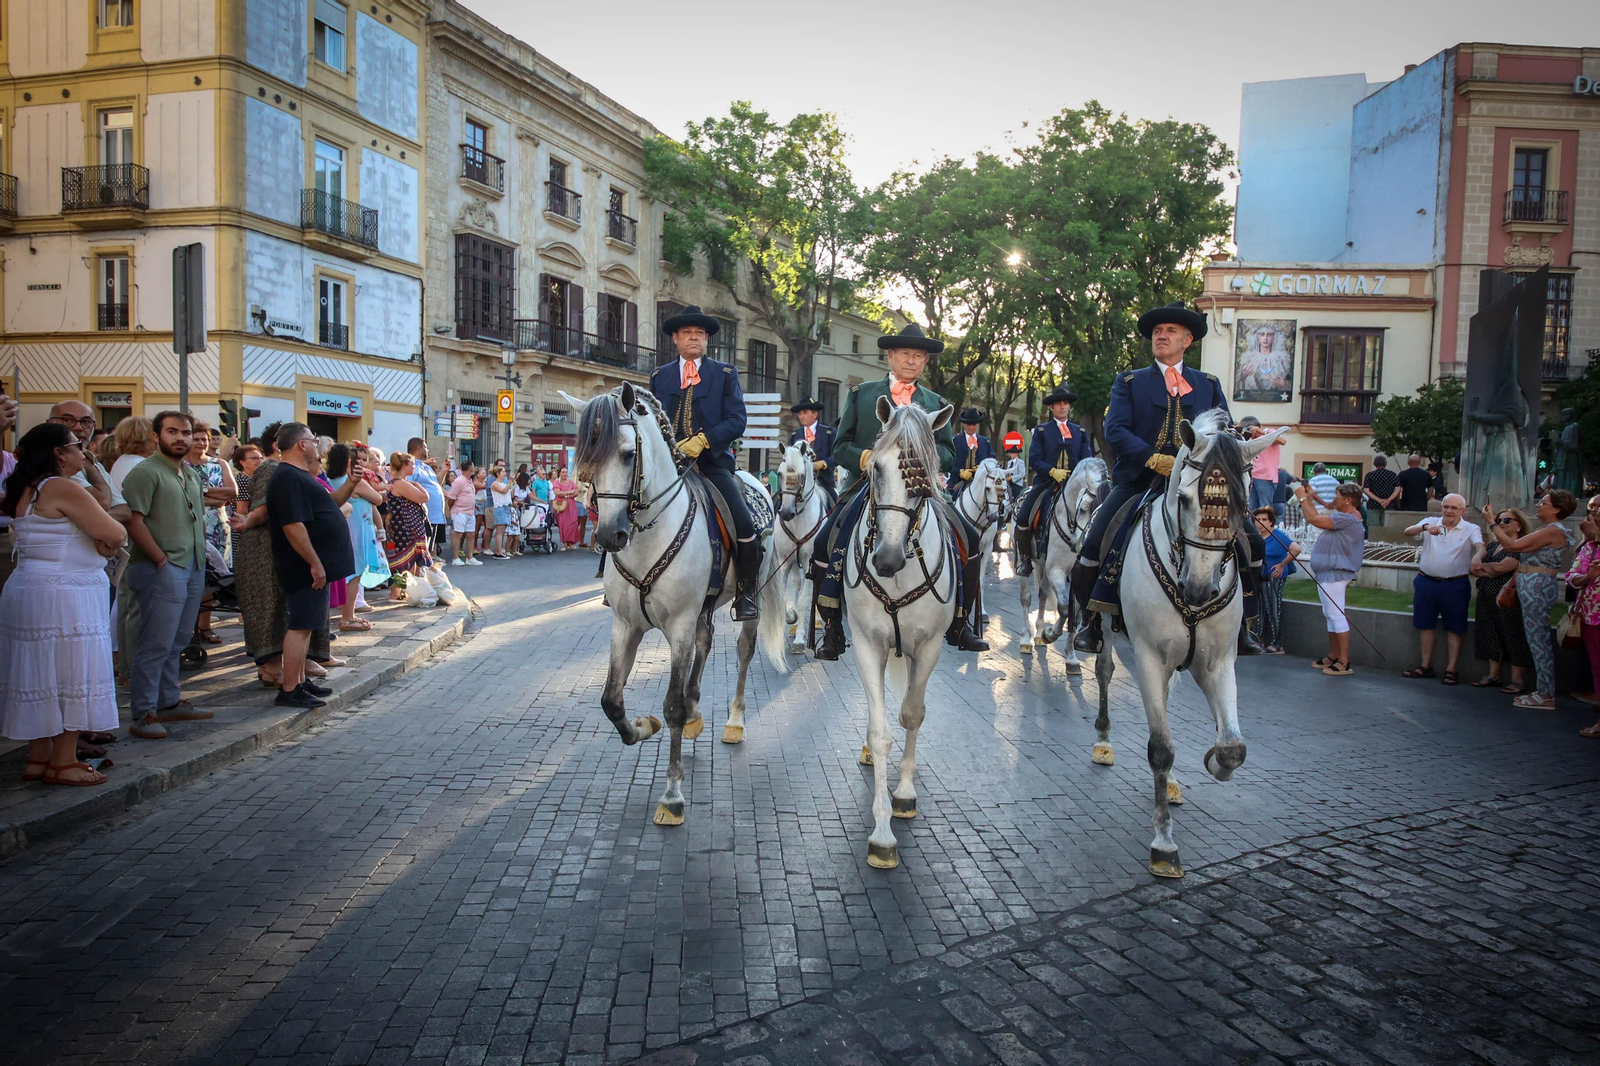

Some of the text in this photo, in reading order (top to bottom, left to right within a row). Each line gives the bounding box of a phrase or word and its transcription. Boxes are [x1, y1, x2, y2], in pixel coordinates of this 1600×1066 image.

[1278, 273, 1386, 295] GORMAZ
[309, 397, 342, 410] iberCaja
[1324, 468, 1356, 477] ORMAZ
